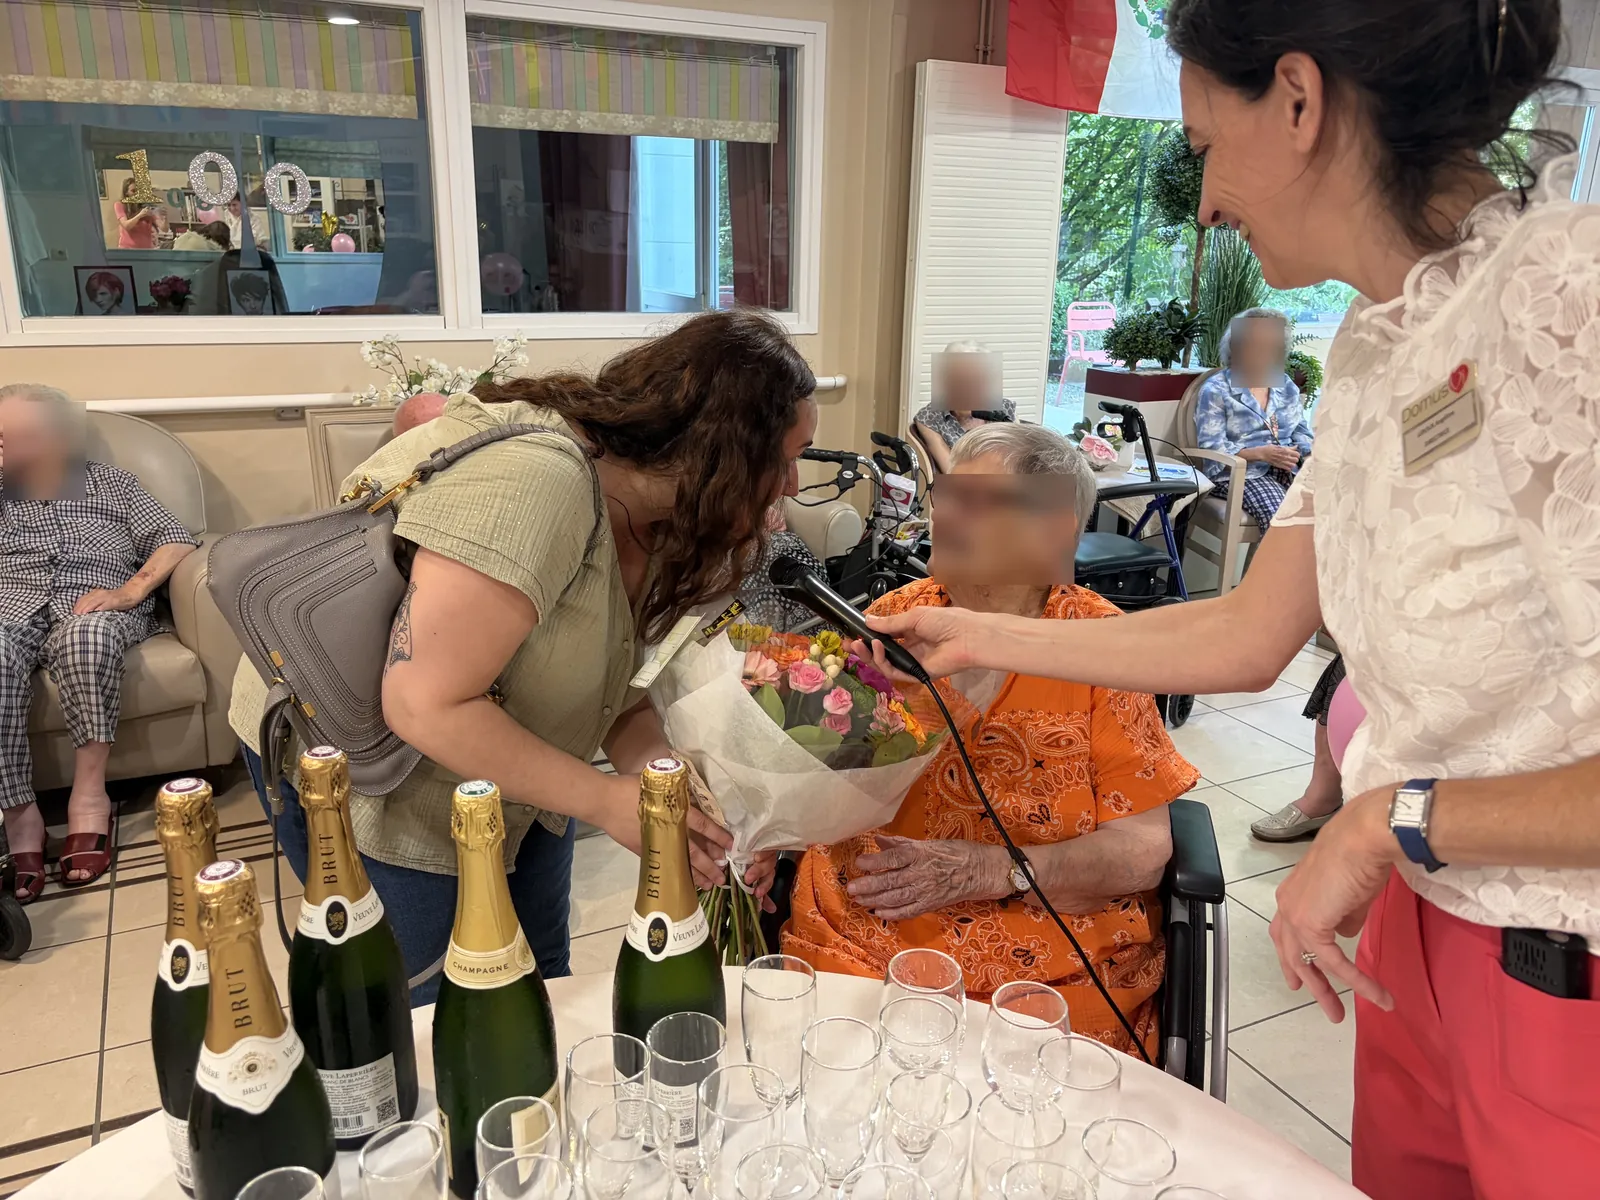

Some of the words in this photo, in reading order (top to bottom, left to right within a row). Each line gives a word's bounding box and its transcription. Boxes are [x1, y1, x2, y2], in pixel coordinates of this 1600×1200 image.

[318, 834, 337, 884] BRUT
[646, 845, 661, 899] BRUT
[170, 875, 185, 927] BRUT
[353, 907, 374, 922] VEUVE
[672, 927, 695, 942] VEUVE
[452, 961, 509, 974] CHAMPAGNE
[225, 967, 253, 1029] BRUT
[242, 1082, 269, 1096] BRUT
